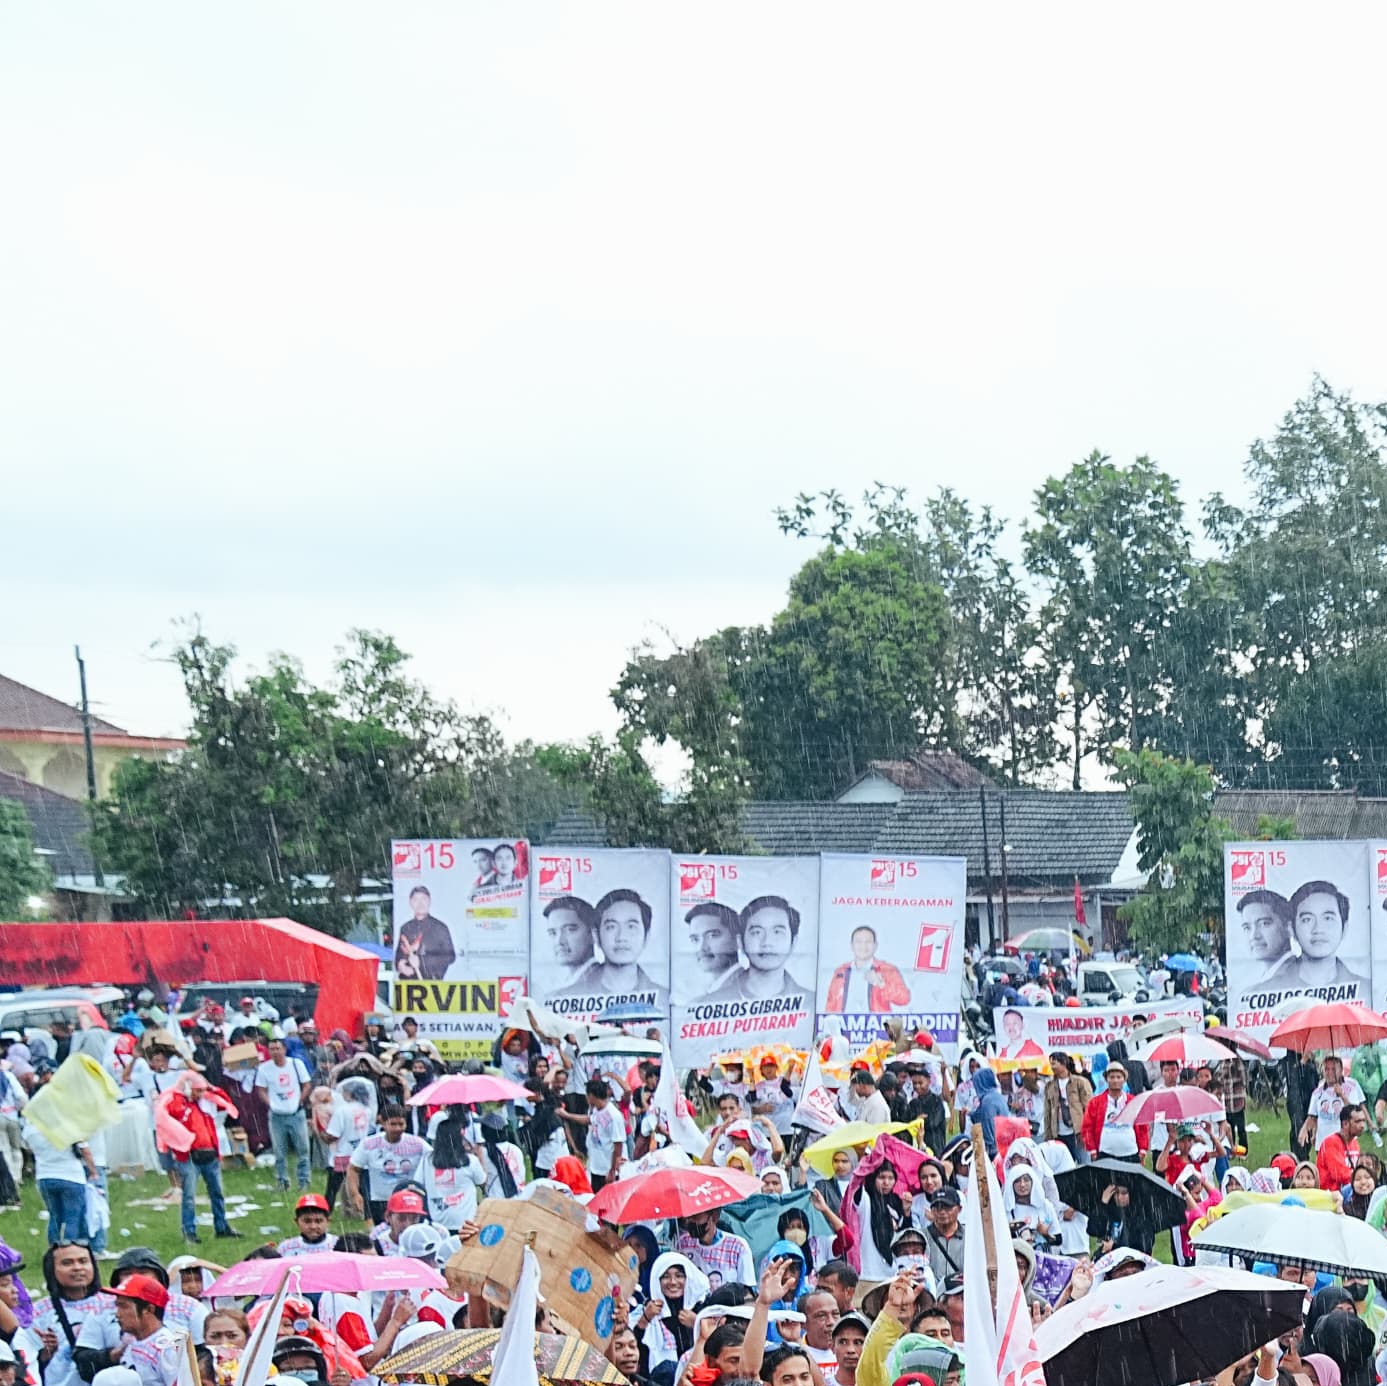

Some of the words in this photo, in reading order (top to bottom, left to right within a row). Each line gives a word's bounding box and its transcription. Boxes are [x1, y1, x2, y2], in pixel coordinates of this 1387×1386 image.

[424, 842, 454, 869] 15
[1269, 851, 1286, 866] 15
[575, 858, 592, 873] 15
[720, 865, 738, 880] 15
[900, 862, 917, 878] 15
[832, 896, 862, 905] JAGA
[866, 897, 953, 907] KEBERAGAMAN
[395, 984, 496, 1012] IRVIN
[749, 996, 803, 1015] GIBRAN
[1235, 1011, 1284, 1028] SEKA
[430, 1023, 497, 1033] SETIAWAN,
[680, 1021, 729, 1040] SEKALI
